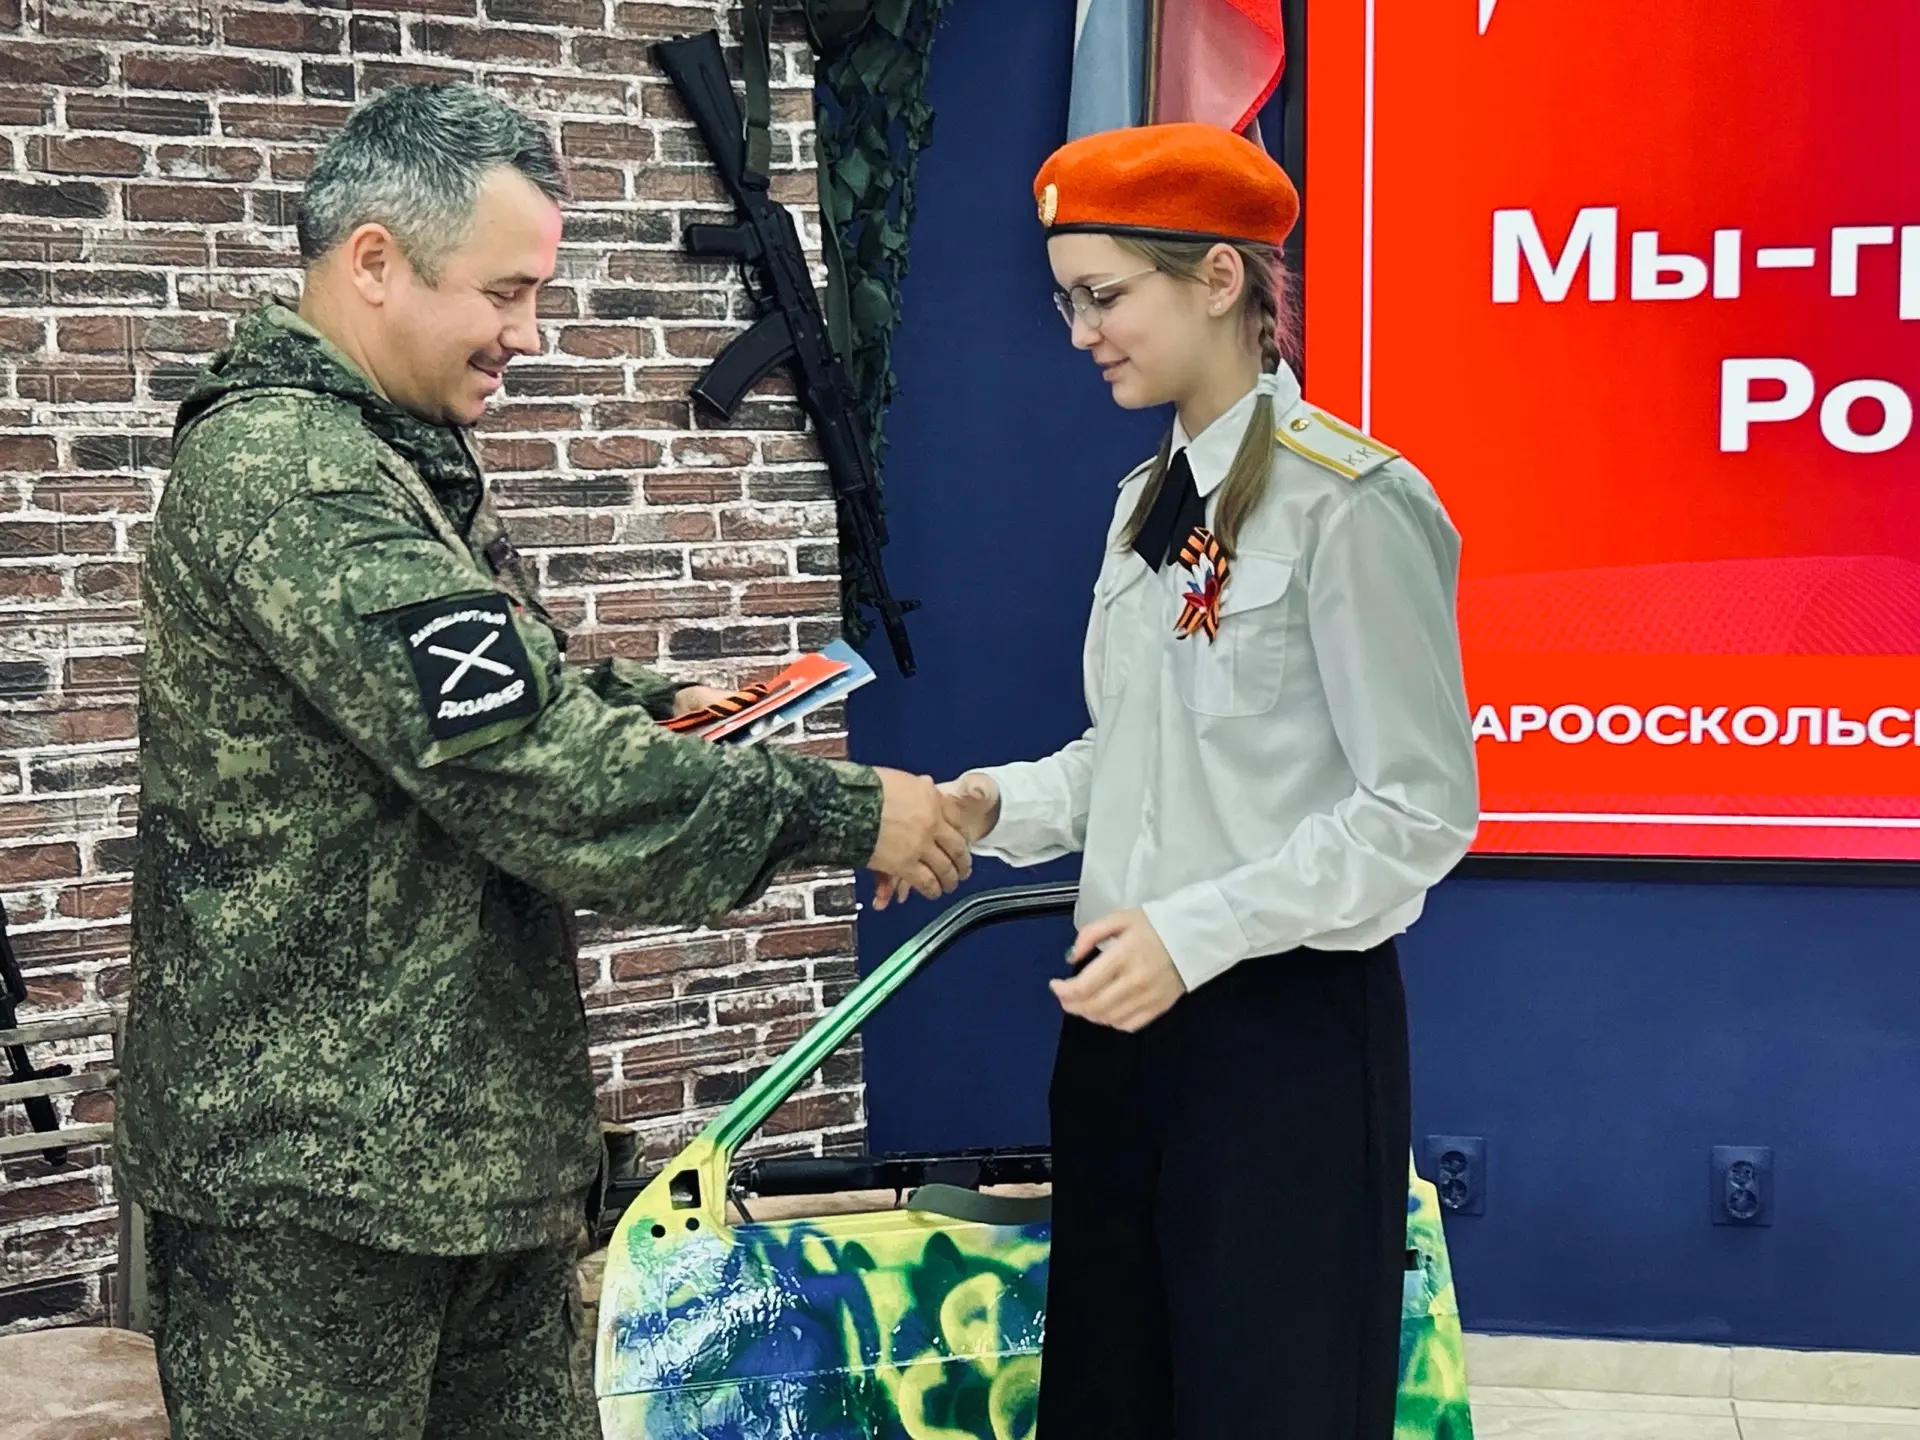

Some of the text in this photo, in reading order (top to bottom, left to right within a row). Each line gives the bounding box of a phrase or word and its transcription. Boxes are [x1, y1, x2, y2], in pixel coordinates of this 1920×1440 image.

[1492, 207, 1920, 320] Мы-г
[1720, 358, 1912, 453] Ро
[1472, 704, 1920, 747] АРООСКОЛЬС
